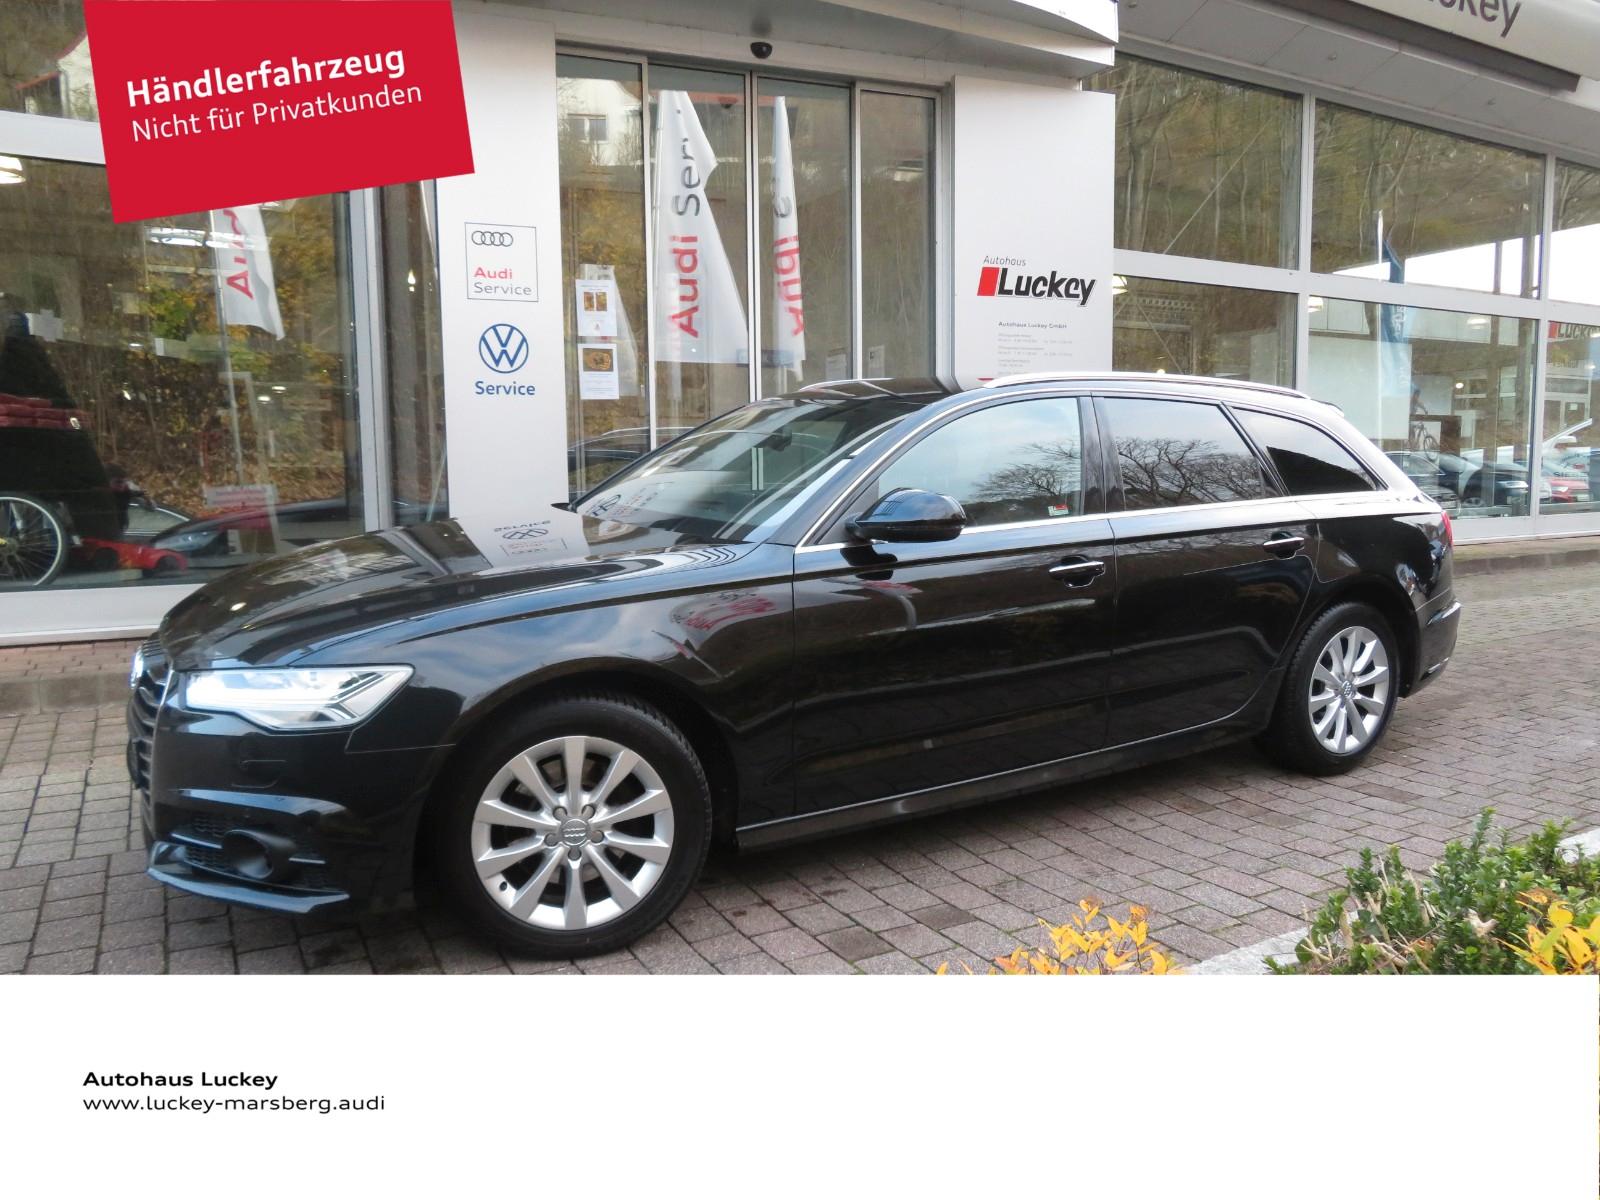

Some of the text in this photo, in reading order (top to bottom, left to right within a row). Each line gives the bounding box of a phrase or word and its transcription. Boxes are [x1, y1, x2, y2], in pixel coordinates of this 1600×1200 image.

[983, 256, 1027, 267] Autohaus
[474, 267, 513, 280] Audi
[474, 282, 533, 296] Service
[670, 235, 699, 338] Audi
[997, 267, 1096, 306] Luckey
[475, 380, 536, 396] Service
